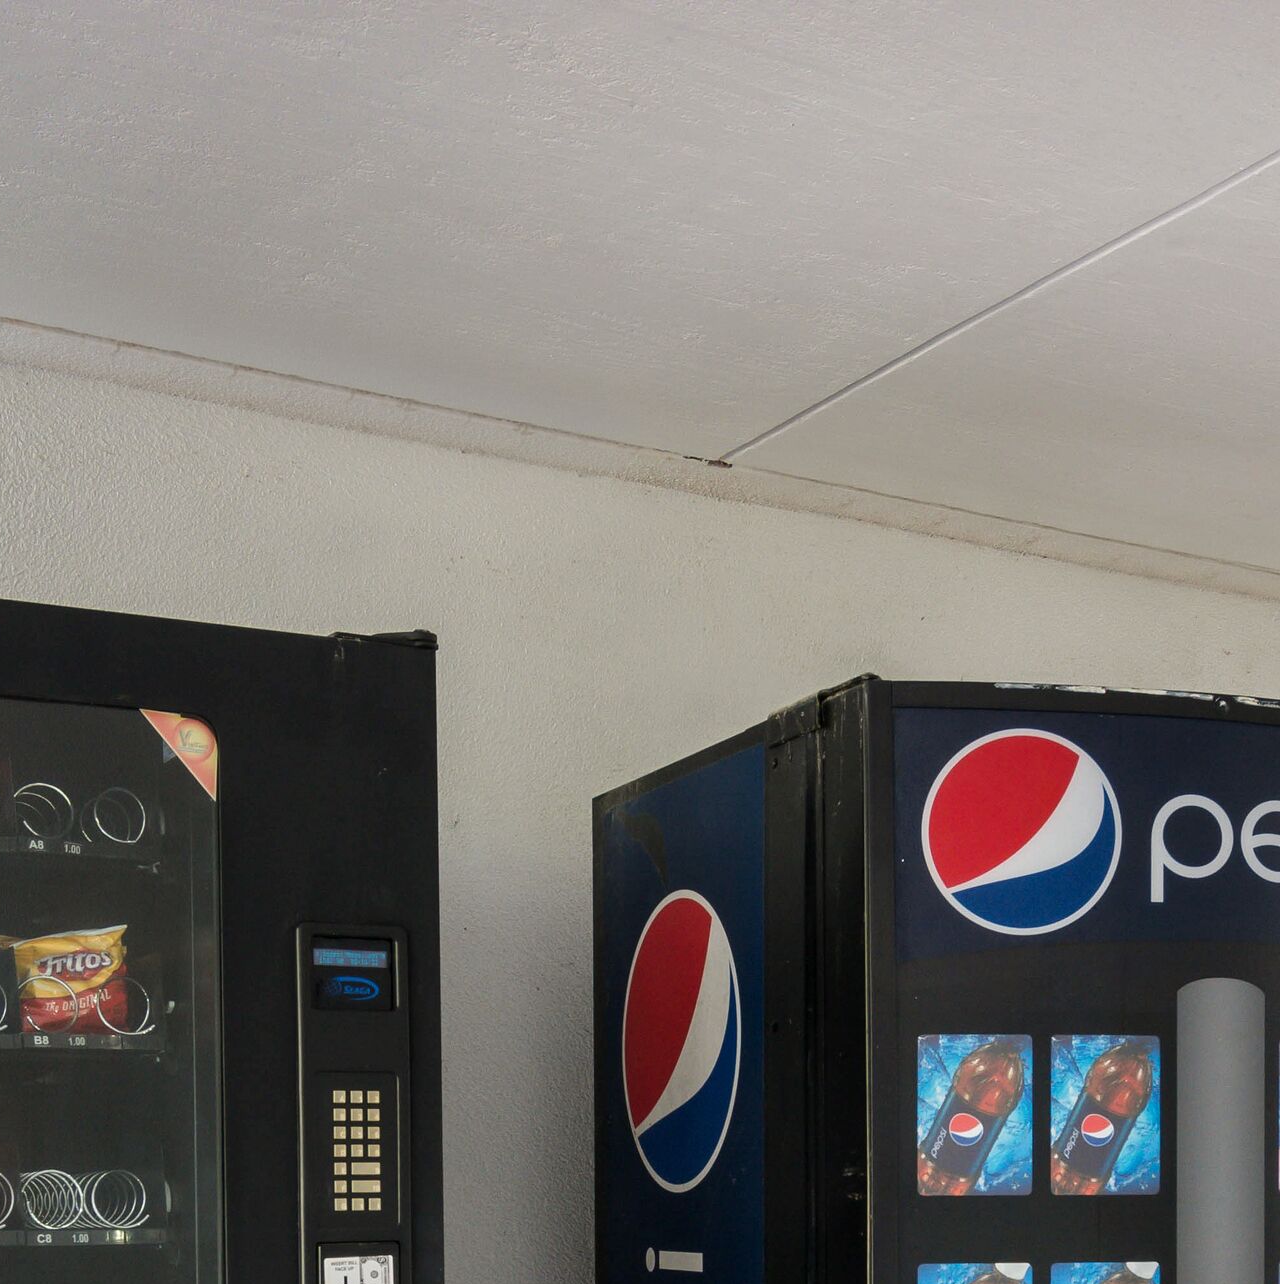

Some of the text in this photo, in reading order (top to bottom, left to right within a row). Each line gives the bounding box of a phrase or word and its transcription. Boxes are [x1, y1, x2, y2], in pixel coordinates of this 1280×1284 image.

[29, 840, 81, 854] A8 1.00
[35, 951, 113, 977] Fritos
[34, 1035, 86, 1046] B8 1.00
[930, 1128, 947, 1159] pepsi
[1064, 1128, 1080, 1160] pepsi
[37, 1234, 89, 1244] C8 1.00
